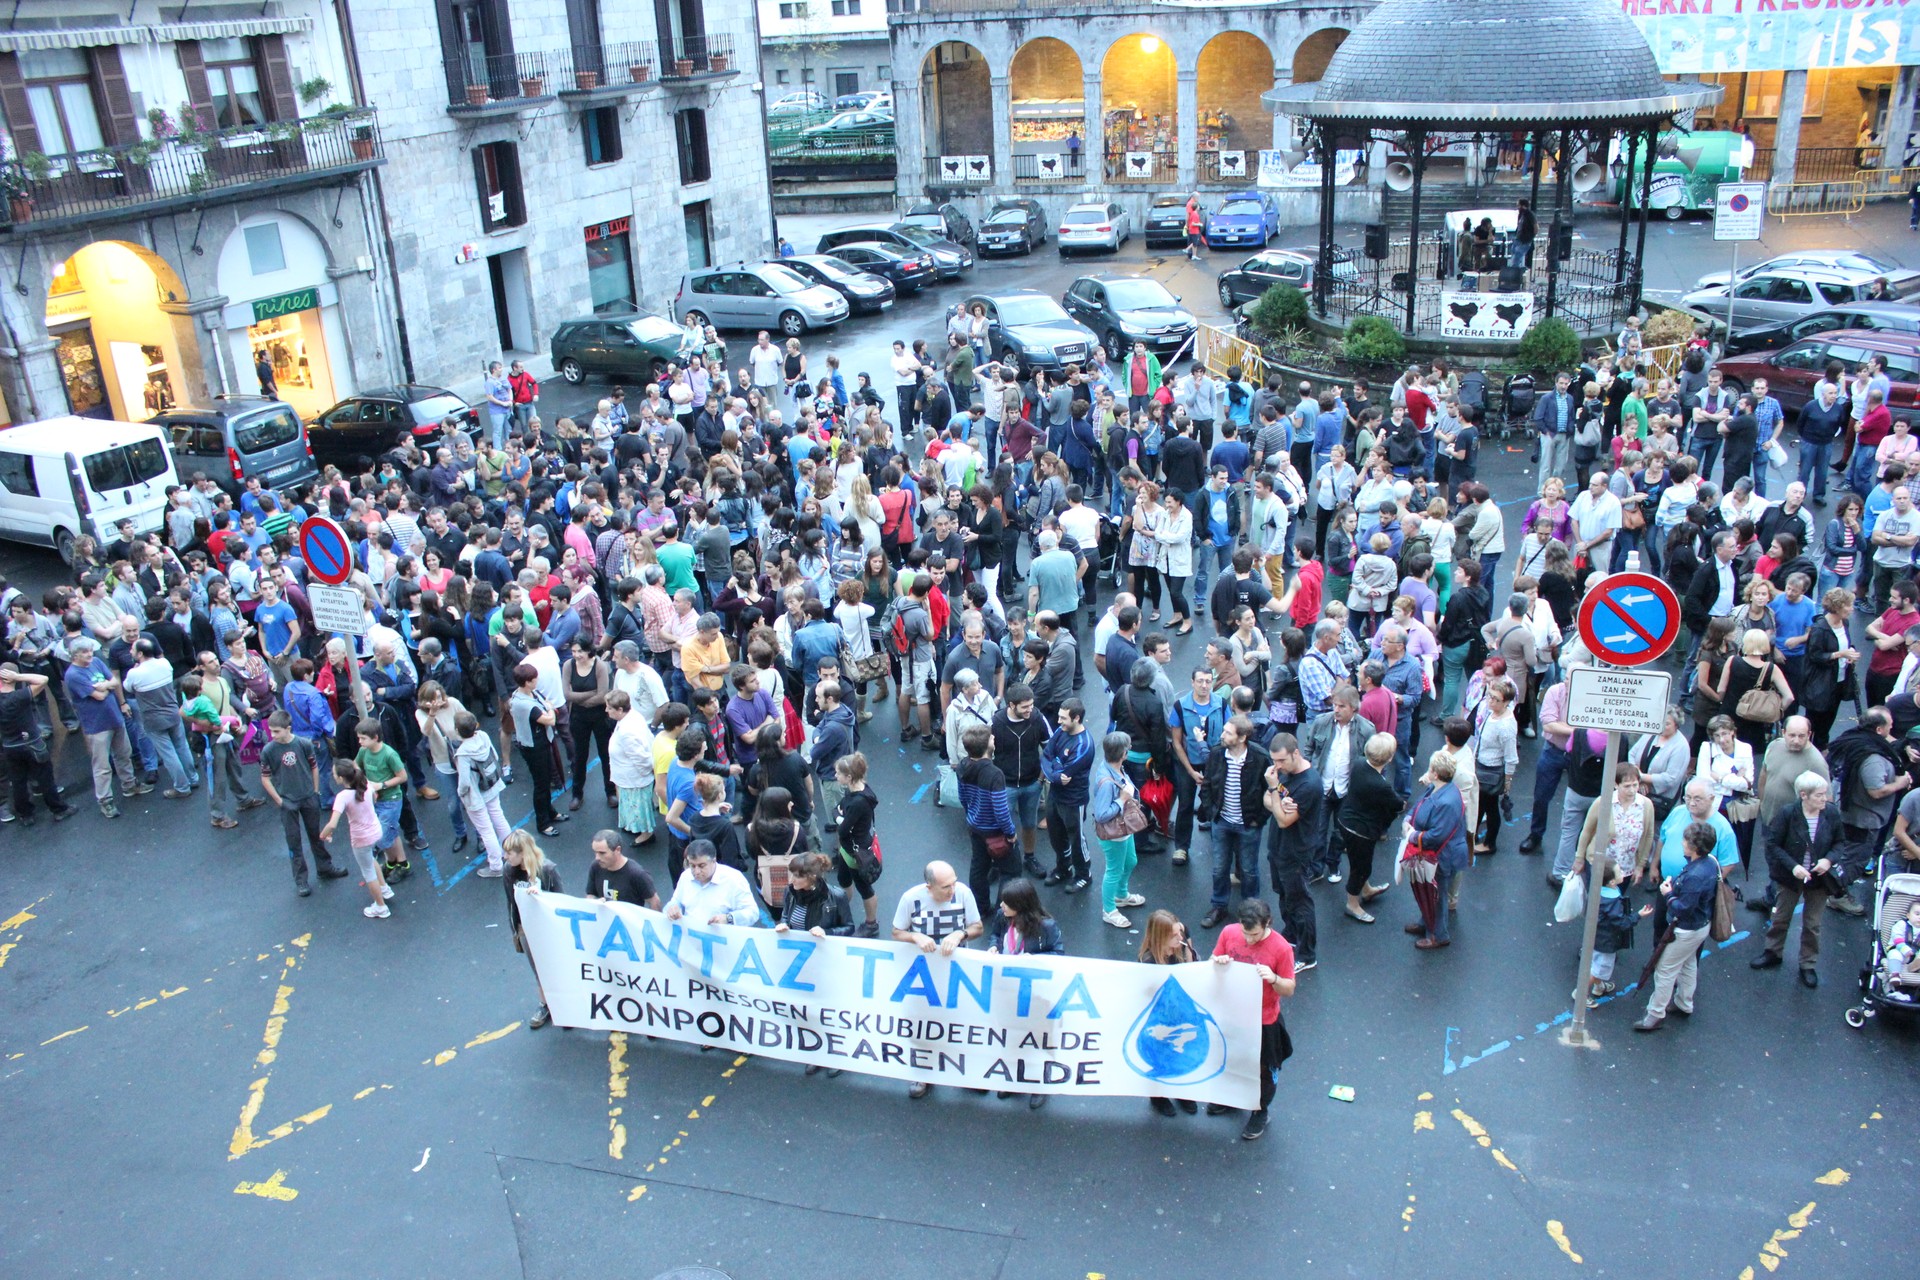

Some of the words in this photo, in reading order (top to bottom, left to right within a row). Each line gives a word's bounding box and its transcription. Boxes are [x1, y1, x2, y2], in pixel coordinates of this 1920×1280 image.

[1444, 327, 1485, 337] ETXERA
[1489, 329, 1519, 338] ETXE
[1597, 675, 1643, 686] ZAMALANAK
[1601, 685, 1619, 694] IZAN
[1621, 687, 1636, 695] EZIK
[1603, 698, 1632, 707] EXCEPTO
[1584, 706, 1606, 715] CARGA
[1614, 709, 1649, 718] DESCARGA
[1597, 717, 1614, 725] 13:00
[1643, 721, 1660, 730] 19:00
[555, 908, 816, 992] TANTAZ
[846, 946, 1102, 1019] TANTA
[581, 963, 677, 998] EUSKAL
[688, 978, 808, 1021] PRESOEN
[819, 1008, 1007, 1049] ESKUBIDEEN
[1018, 1031, 1102, 1051] ALDE
[590, 992, 966, 1076] KONPONBIDEAREN
[983, 1058, 1104, 1085] ALDE
